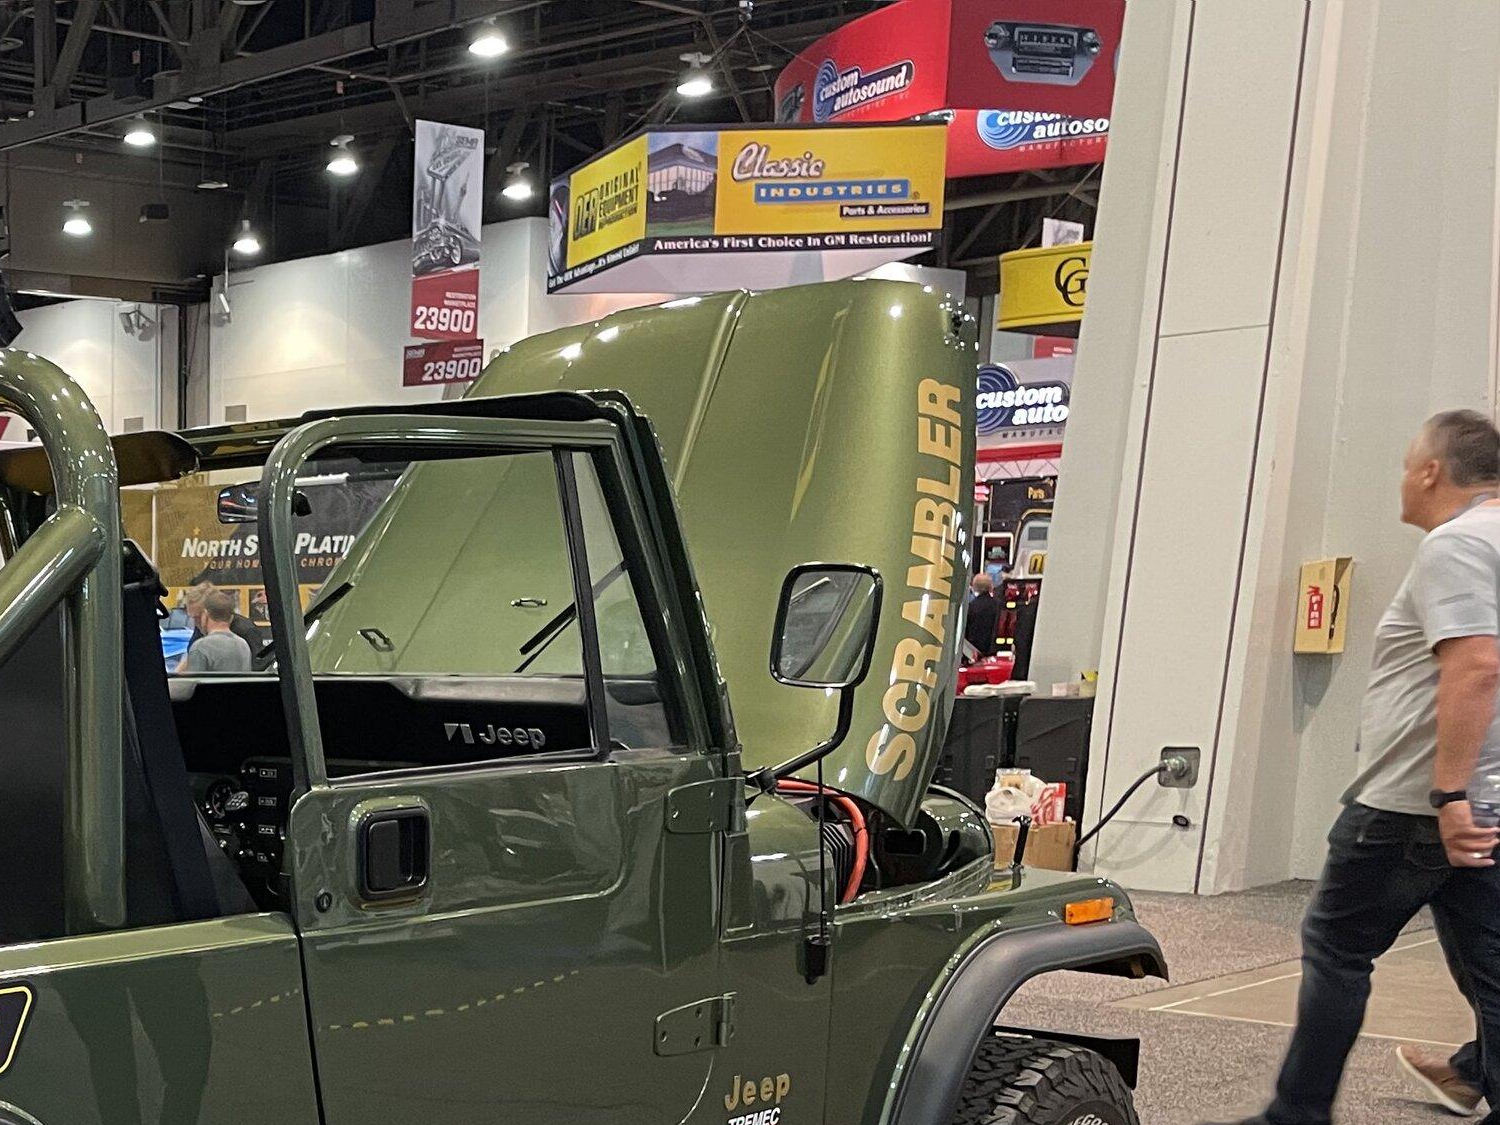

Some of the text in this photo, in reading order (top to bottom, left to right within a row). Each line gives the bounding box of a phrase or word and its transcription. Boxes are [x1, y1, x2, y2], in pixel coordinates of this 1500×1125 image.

[820, 71, 860, 102] custom
[997, 110, 1074, 126] cust
[1032, 118, 1110, 140] autoso
[731, 142, 825, 182] Classic
[599, 166, 639, 200] ORIGINAL
[760, 183, 903, 198] INDUSTRIES
[842, 205, 866, 216] Parts
[876, 203, 927, 215] Accessories
[654, 230, 934, 251] America's First Choice In GM Restoration!
[413, 305, 476, 334] 23900
[421, 357, 482, 382] 23900
[975, 385, 1062, 410] custom
[1002, 428, 1062, 439] MANUFAC
[235, 559, 260, 569] HOM
[301, 557, 337, 568] CHRO
[865, 377, 963, 782] SCRAMBLER
[478, 723, 547, 750] Jeep
[724, 1072, 791, 1112] Jeep
